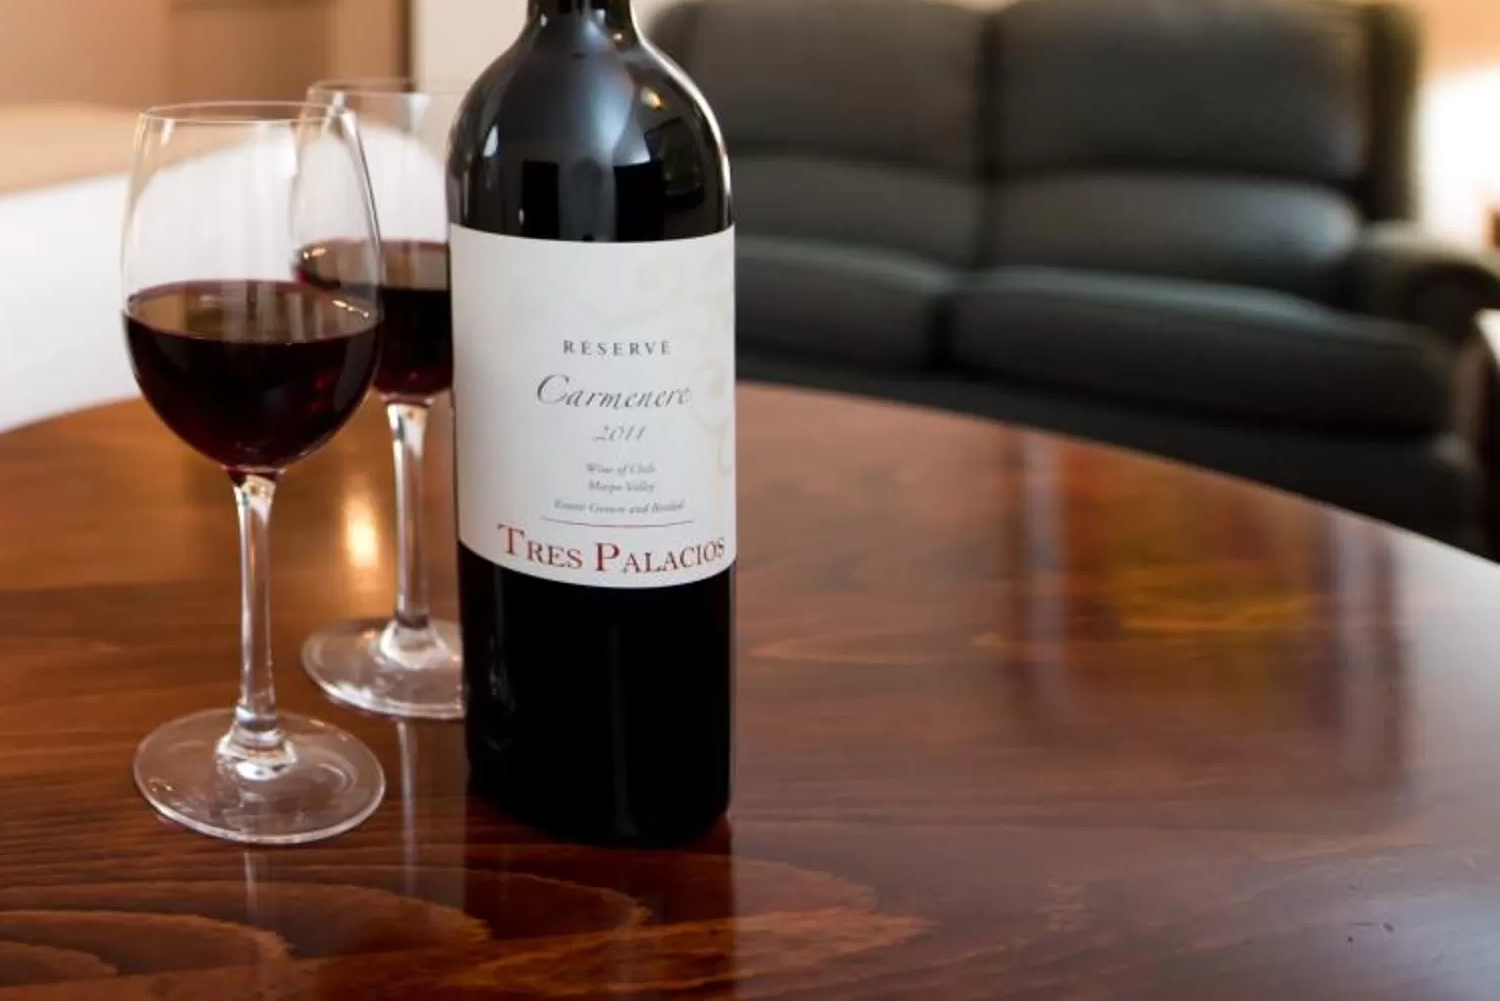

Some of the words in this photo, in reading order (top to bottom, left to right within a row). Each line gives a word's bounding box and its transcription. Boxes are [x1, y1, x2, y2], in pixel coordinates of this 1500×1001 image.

[562, 340, 671, 356] RESERVE
[536, 373, 691, 410] Carmenere
[594, 425, 646, 441] 2011
[497, 523, 583, 570] TRES
[595, 537, 726, 574] PALACIOS
